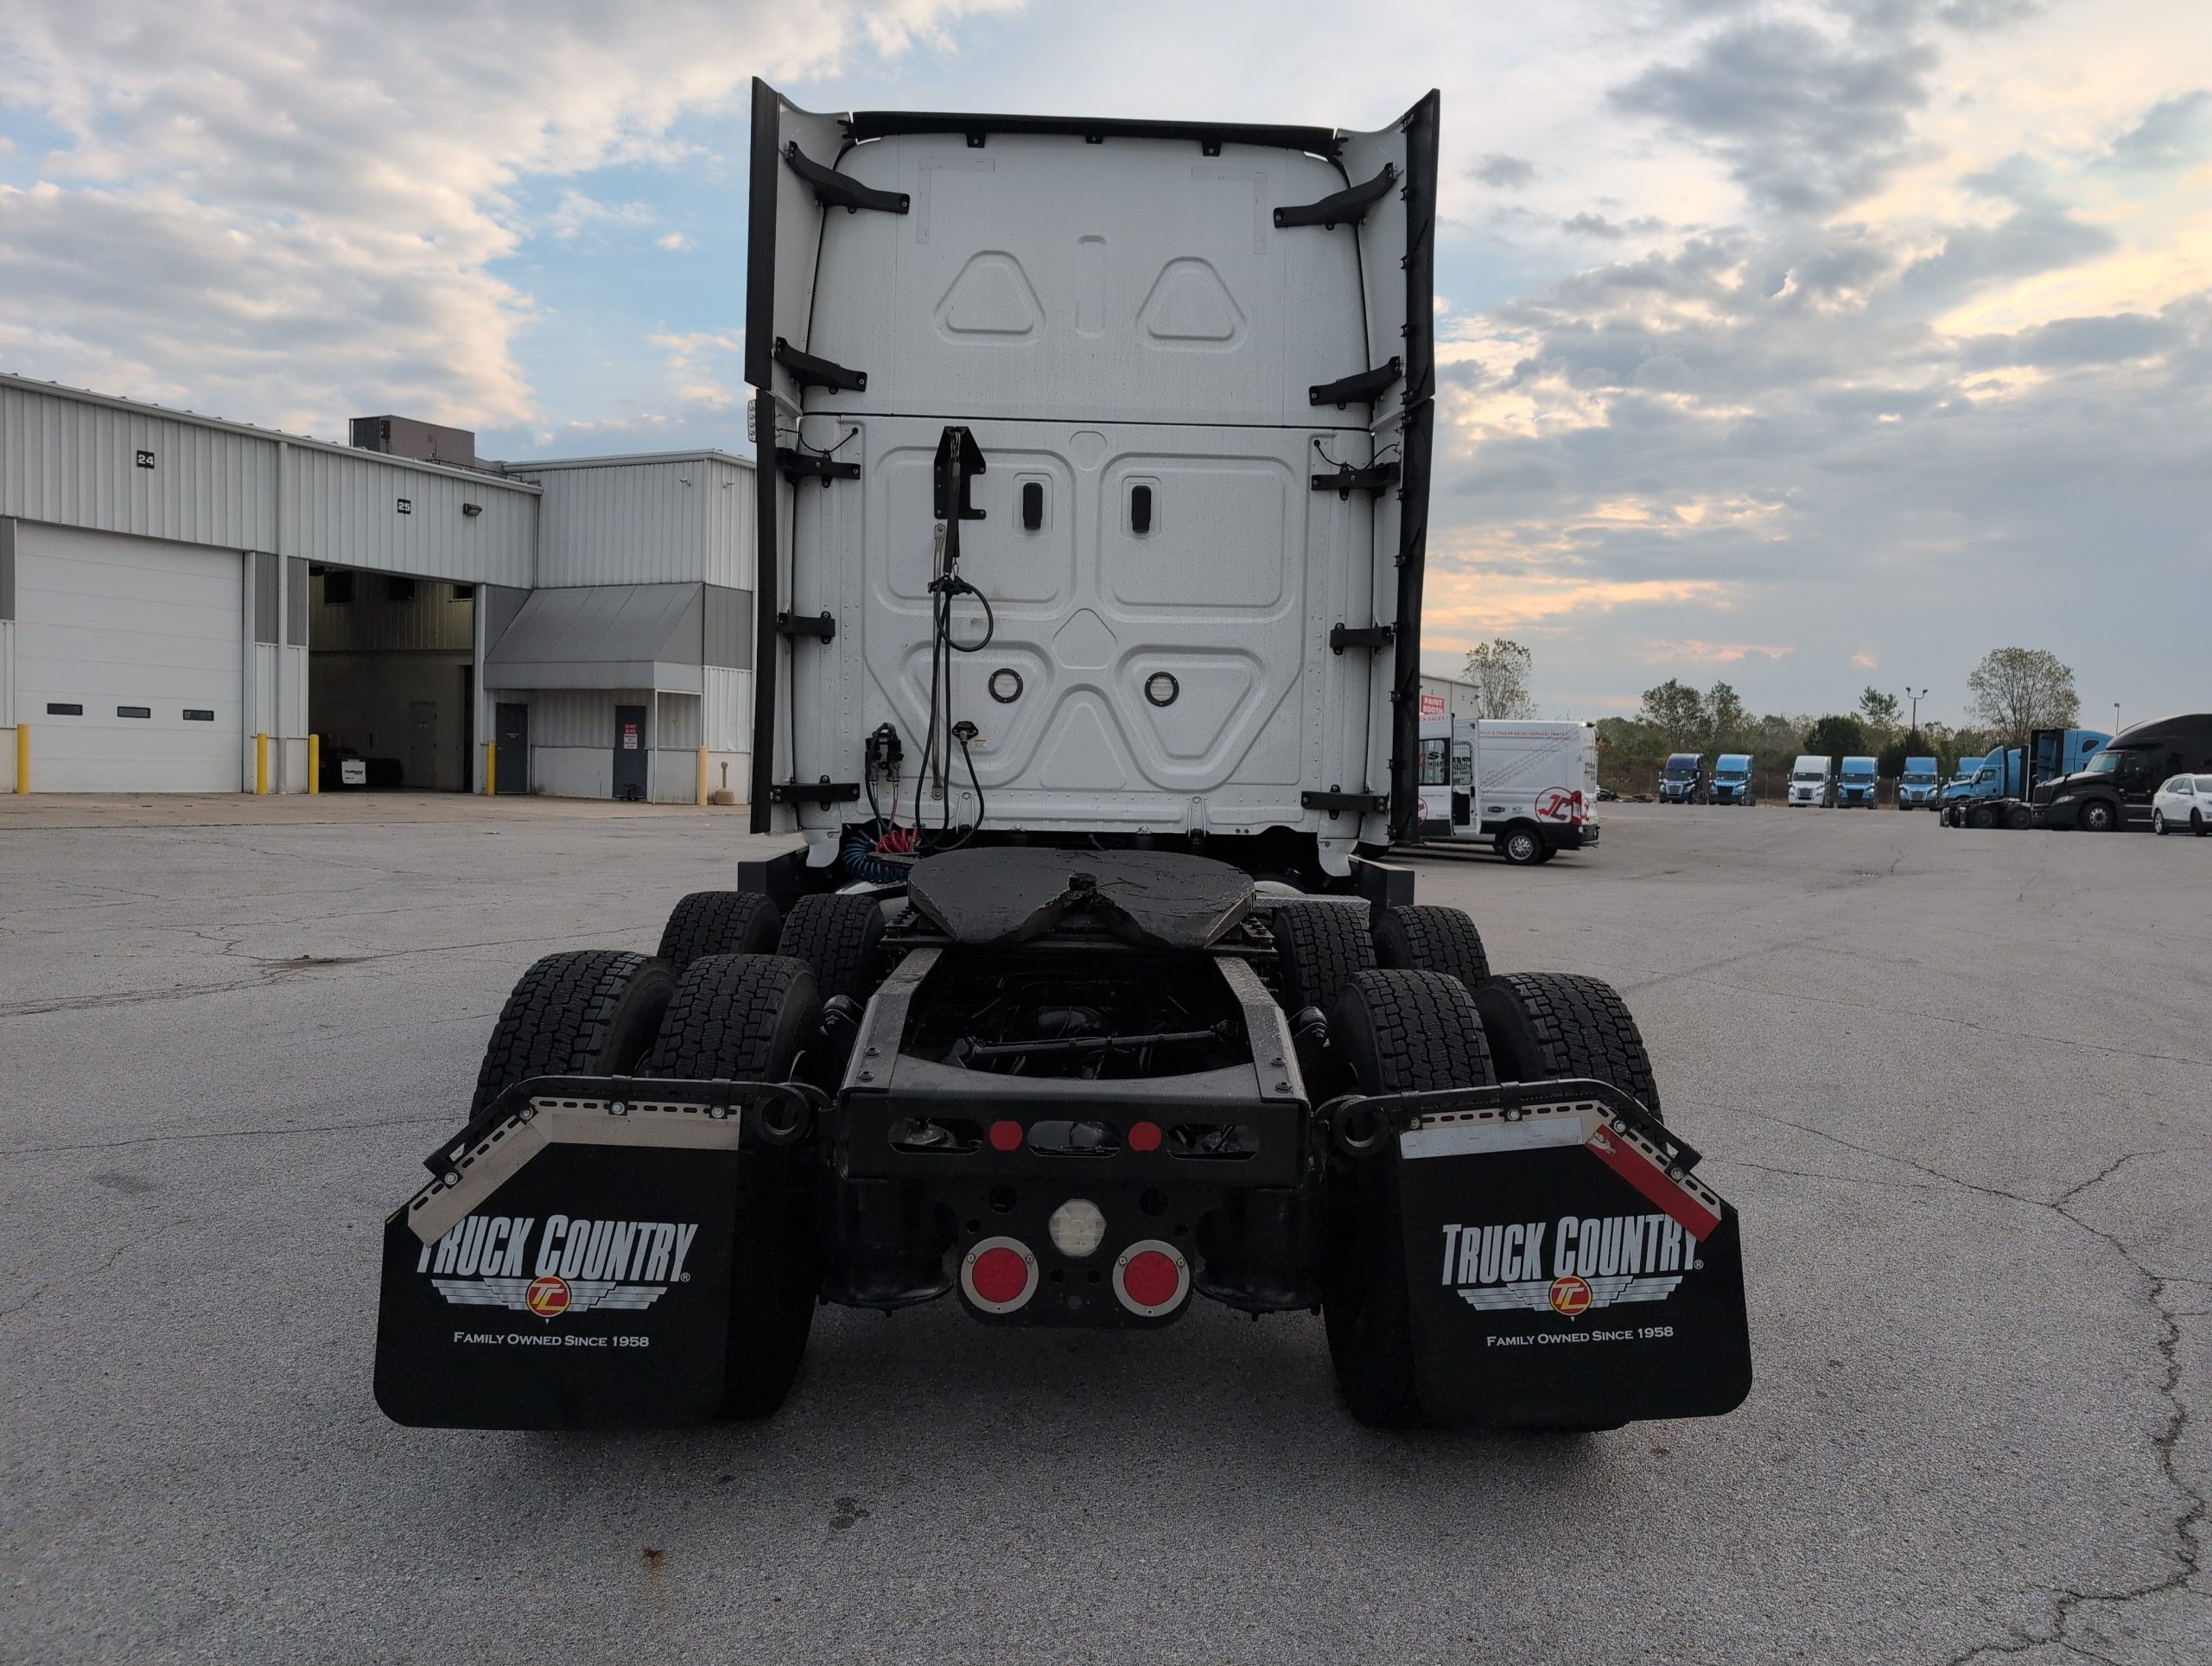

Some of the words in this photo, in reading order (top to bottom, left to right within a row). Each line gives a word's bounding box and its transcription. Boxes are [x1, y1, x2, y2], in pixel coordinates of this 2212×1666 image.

[138, 454, 154, 466] 24
[398, 501, 410, 512] 25
[1424, 697, 1443, 707] PAINT
[1423, 705, 1443, 715] BOOTH
[535, 1215, 698, 1282] COUNTRY
[1442, 1222, 1547, 1285] TRUCK
[454, 1332, 505, 1345] FAMILY
[507, 1333, 562, 1345] OWNED
[564, 1335, 607, 1347] SINCE
[613, 1336, 650, 1347] 1958
[1486, 1335, 1535, 1347] FAMILY
[1537, 1333, 1590, 1345] OWNED
[1592, 1330, 1634, 1341] SINCE
[1637, 1326, 1674, 1339] 1958
